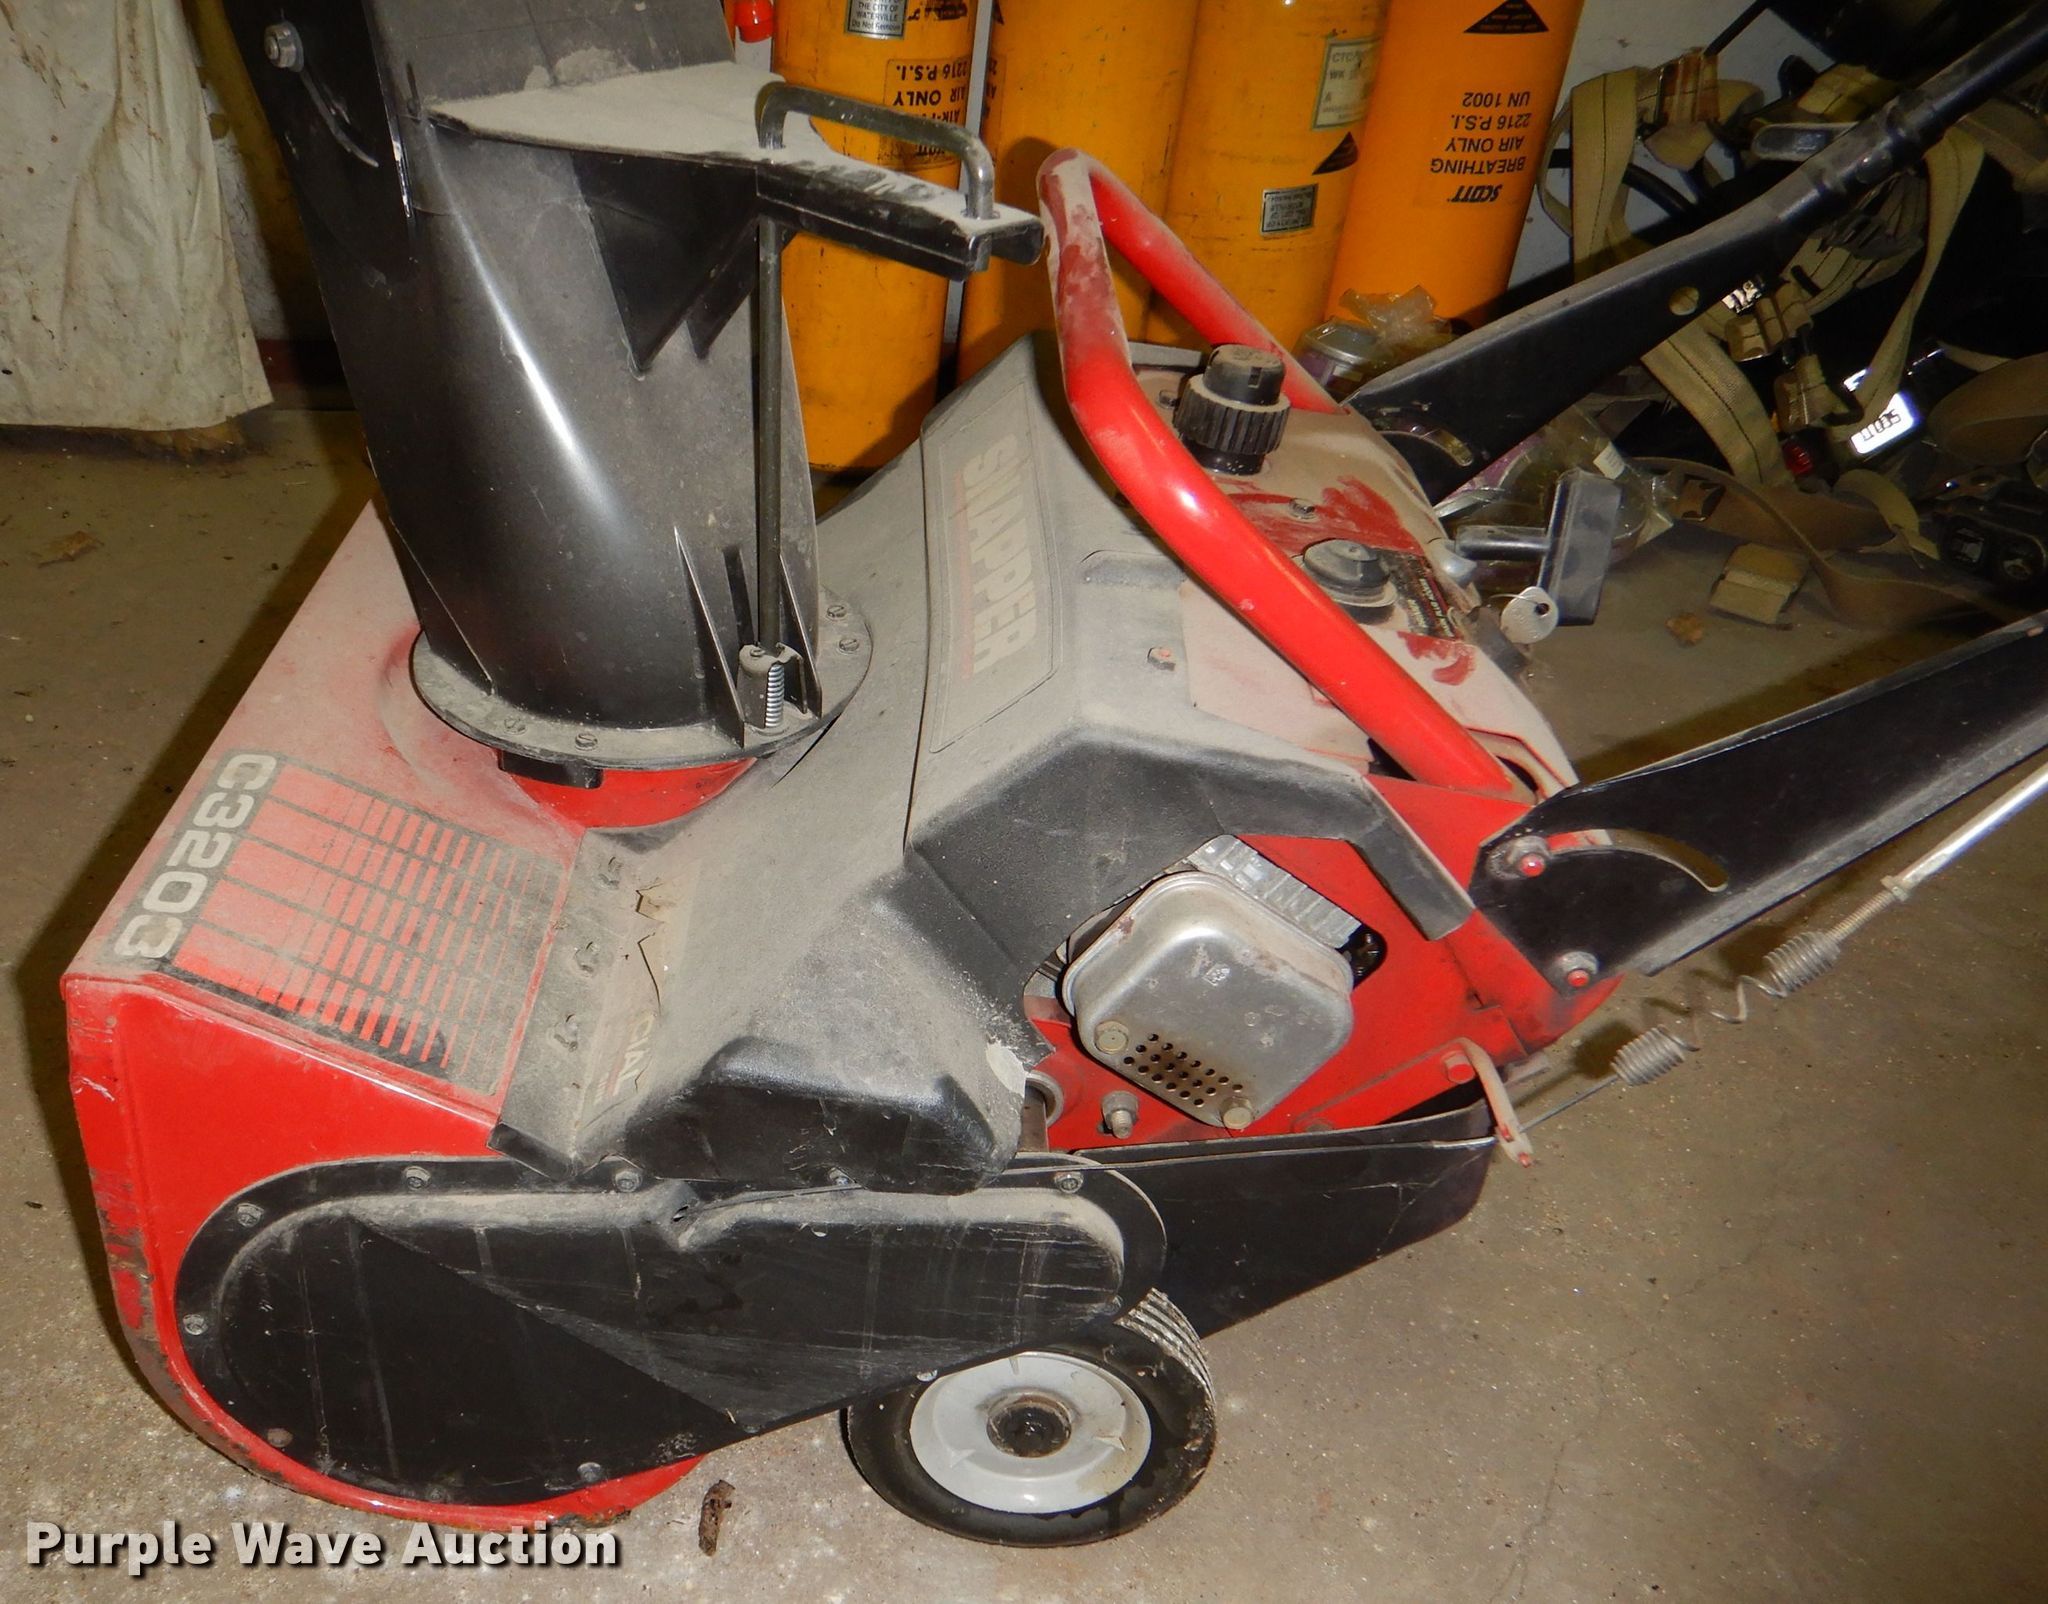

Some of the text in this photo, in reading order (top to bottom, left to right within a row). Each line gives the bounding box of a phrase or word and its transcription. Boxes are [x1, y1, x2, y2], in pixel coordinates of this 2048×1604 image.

[872, 4, 888, 12] CITY
[896, 65, 938, 81] P.S.I.
[942, 59, 968, 80] 2216
[893, 89, 942, 106] ONLY
[950, 85, 966, 103] AIR
[1462, 91, 1530, 108] UN 1002
[1451, 112, 1532, 131] 2216 P.S.I.
[1445, 136, 1525, 153] AIR ONLY
[1430, 156, 1526, 175] BREATHING
[1449, 184, 1503, 203] SCOTT
[961, 434, 1038, 675] SNAPPER
[114, 754, 277, 958] C3203
